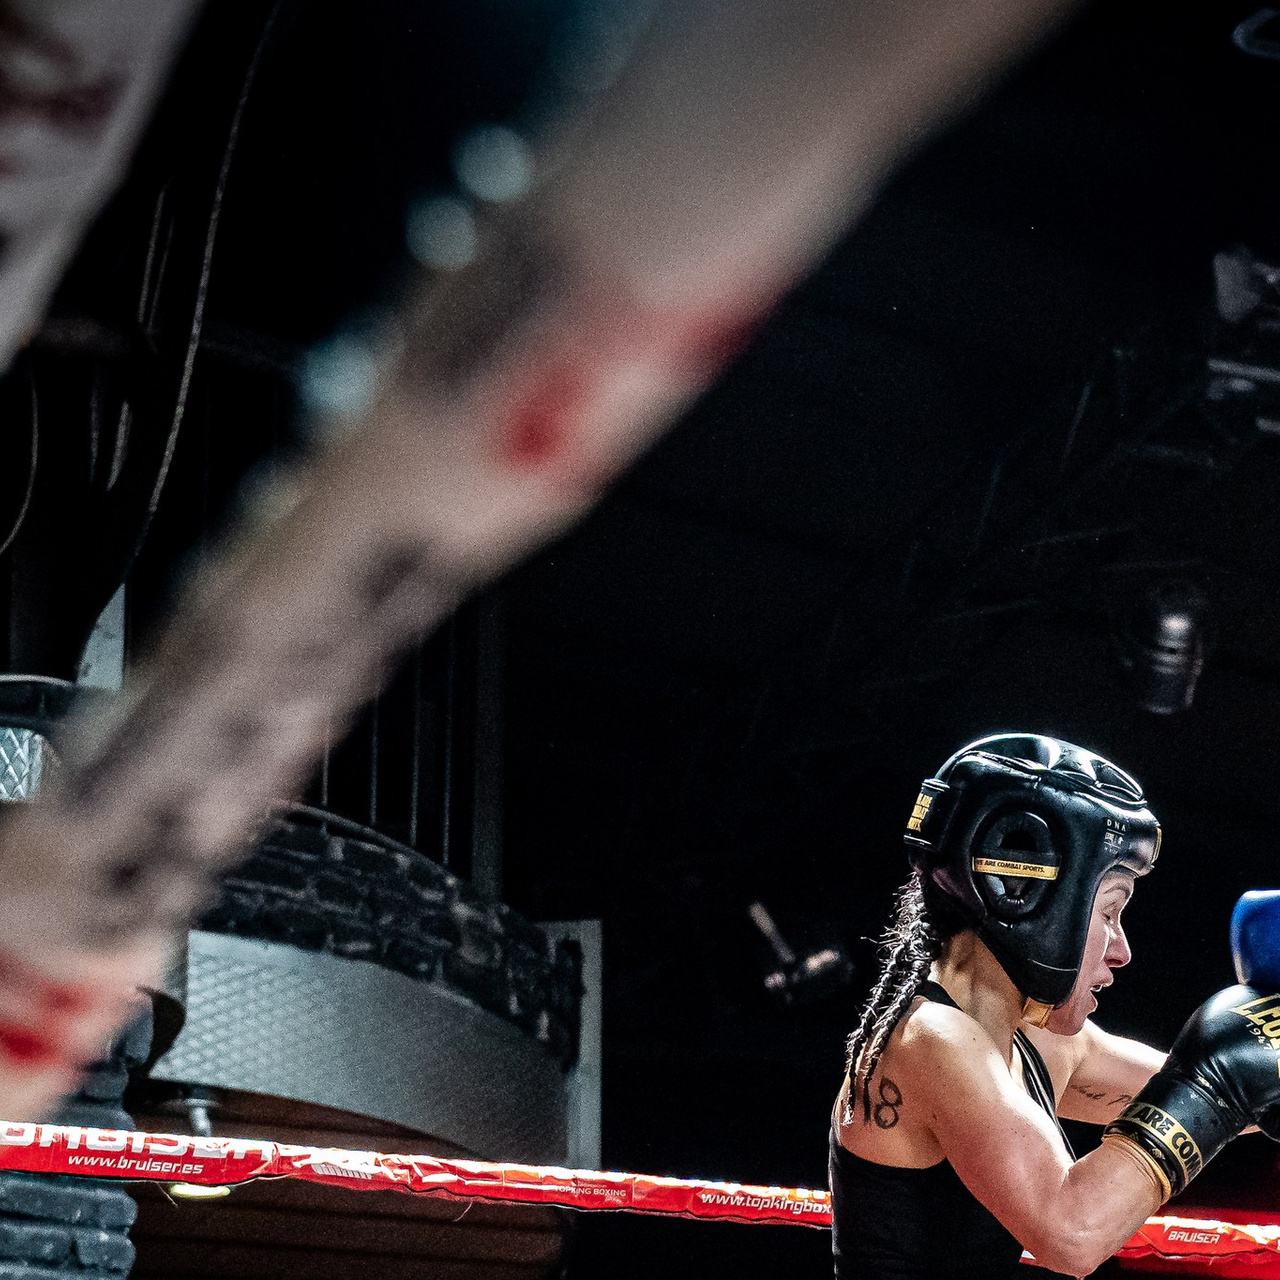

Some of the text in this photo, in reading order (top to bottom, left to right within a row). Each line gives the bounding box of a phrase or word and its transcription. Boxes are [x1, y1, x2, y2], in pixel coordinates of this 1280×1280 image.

[1107, 819, 1126, 832] DNA
[997, 861, 1021, 870] COMBAT
[68, 1154, 203, 1175] www.bruiser.es
[593, 1186, 627, 1198] BOXING
[1167, 1230, 1220, 1244] BRUISER
